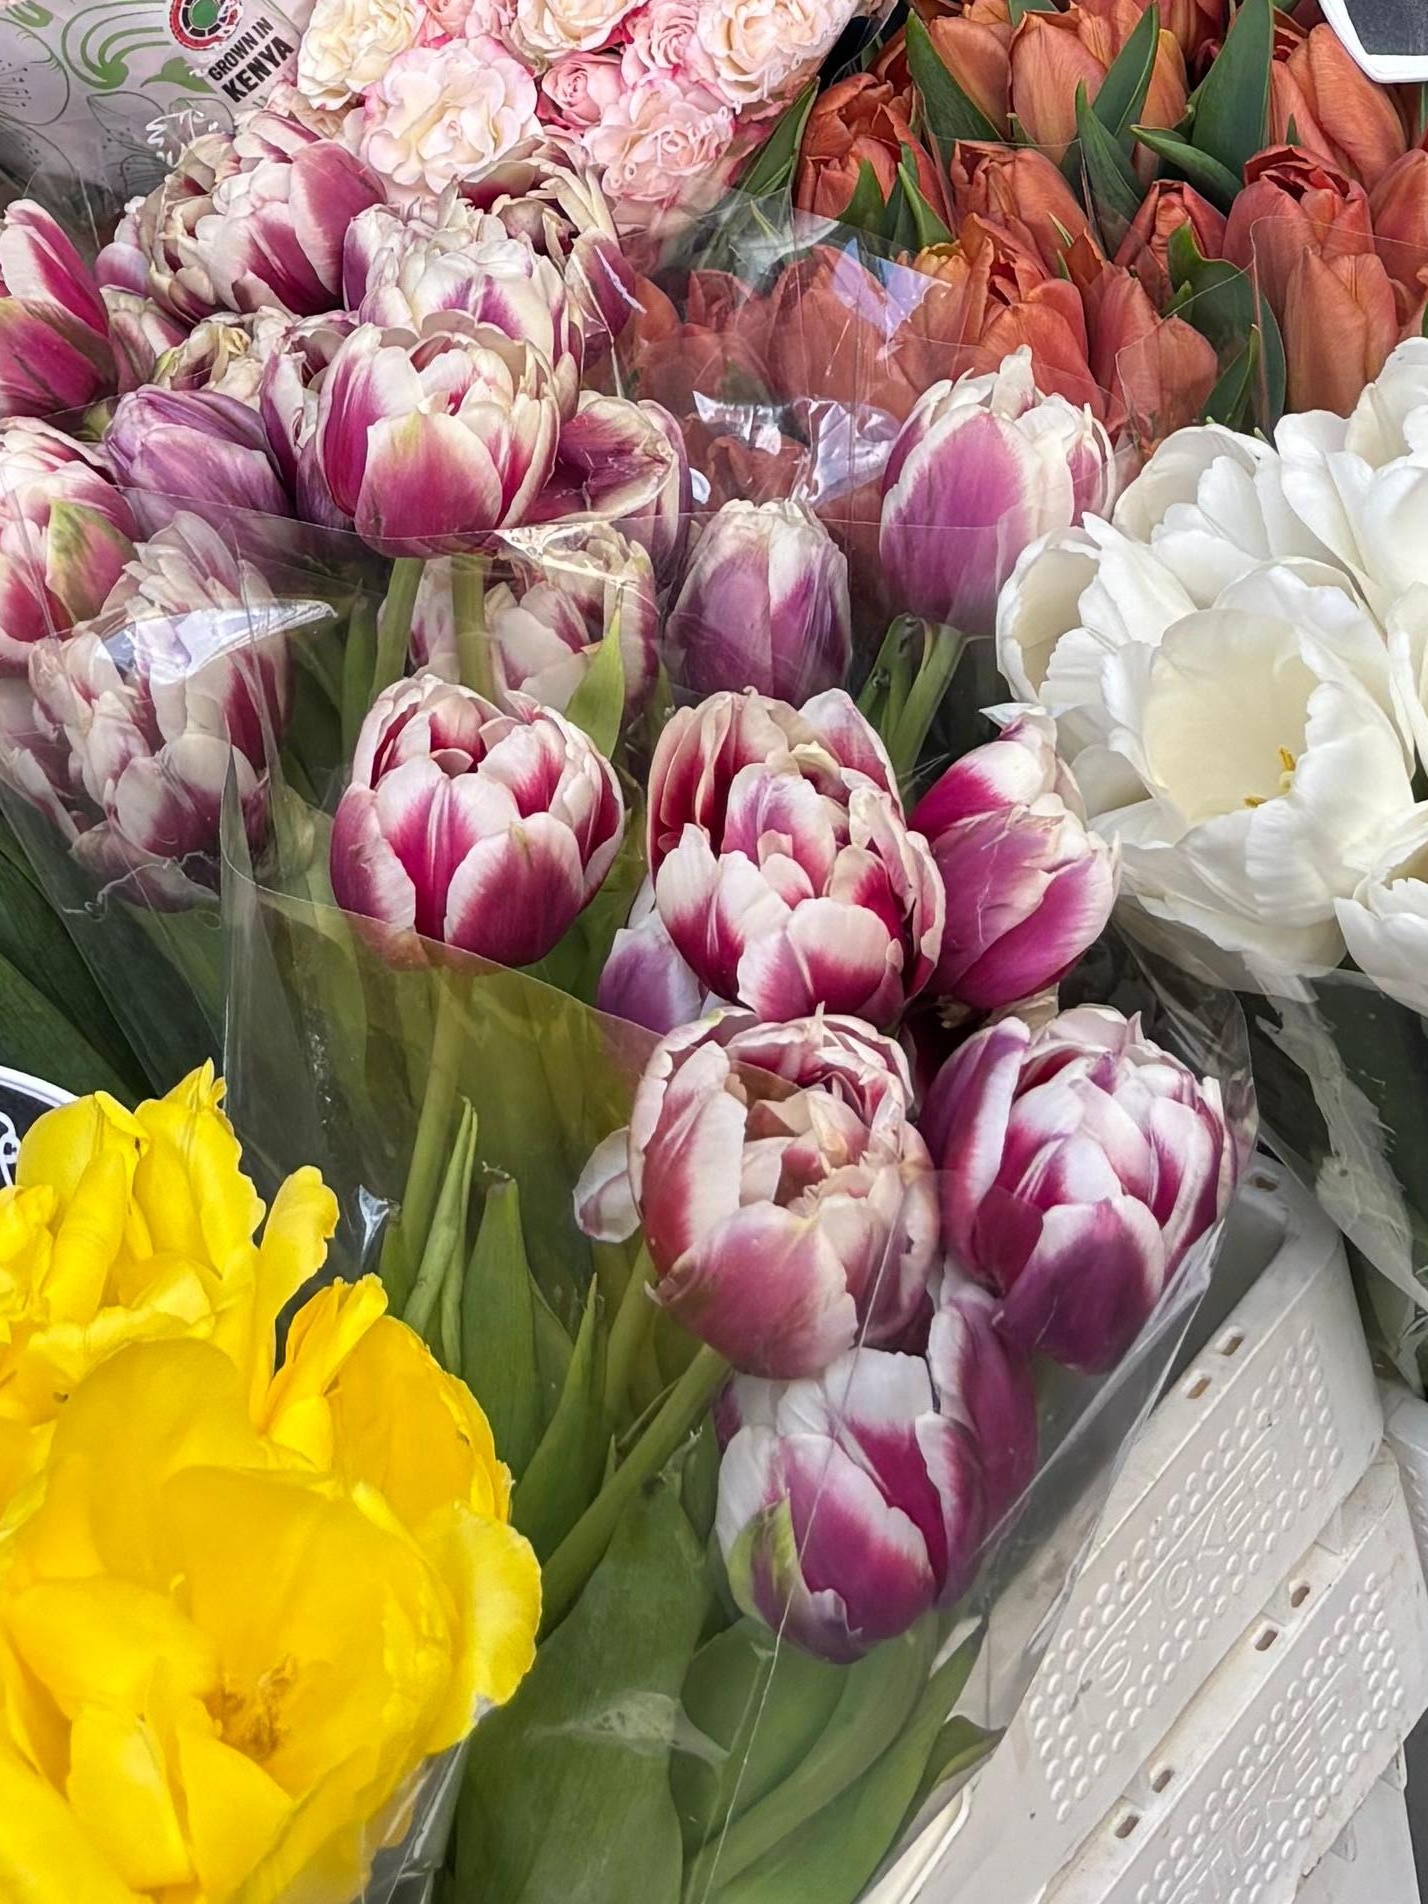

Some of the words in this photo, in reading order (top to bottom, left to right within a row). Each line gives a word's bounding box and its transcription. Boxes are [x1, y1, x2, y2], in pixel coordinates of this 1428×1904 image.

[208, 31, 260, 83] GROWN
[257, 15, 275, 37] IN
[221, 35, 295, 104] KENYA
